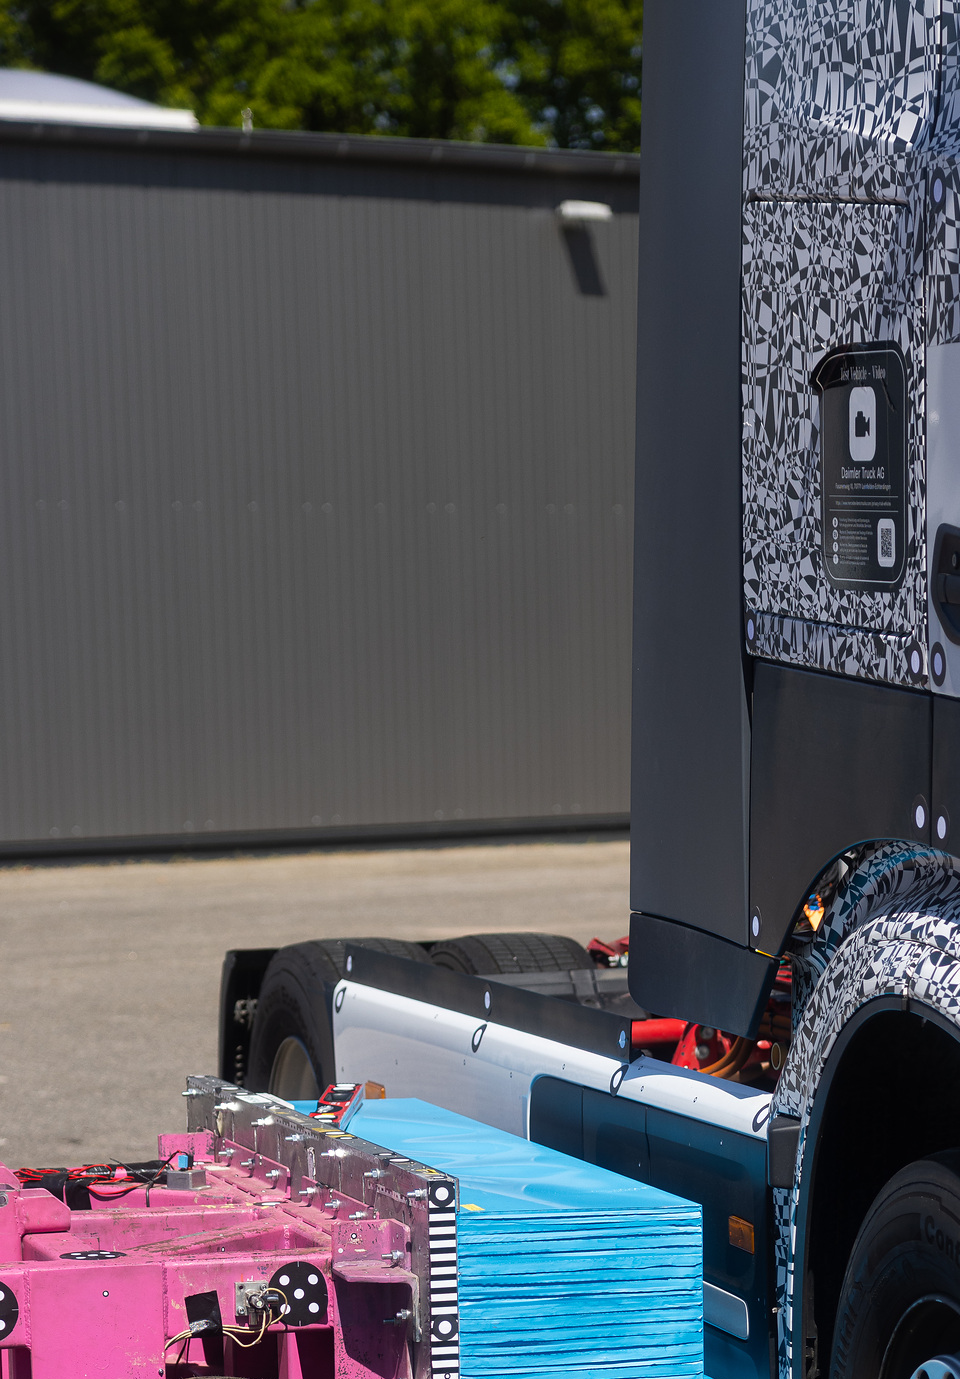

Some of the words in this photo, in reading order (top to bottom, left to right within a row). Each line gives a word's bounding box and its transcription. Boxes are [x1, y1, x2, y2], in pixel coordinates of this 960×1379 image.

[841, 466, 861, 479] Daimler
[861, 466, 876, 479] Truck
[876, 466, 885, 479] AG
